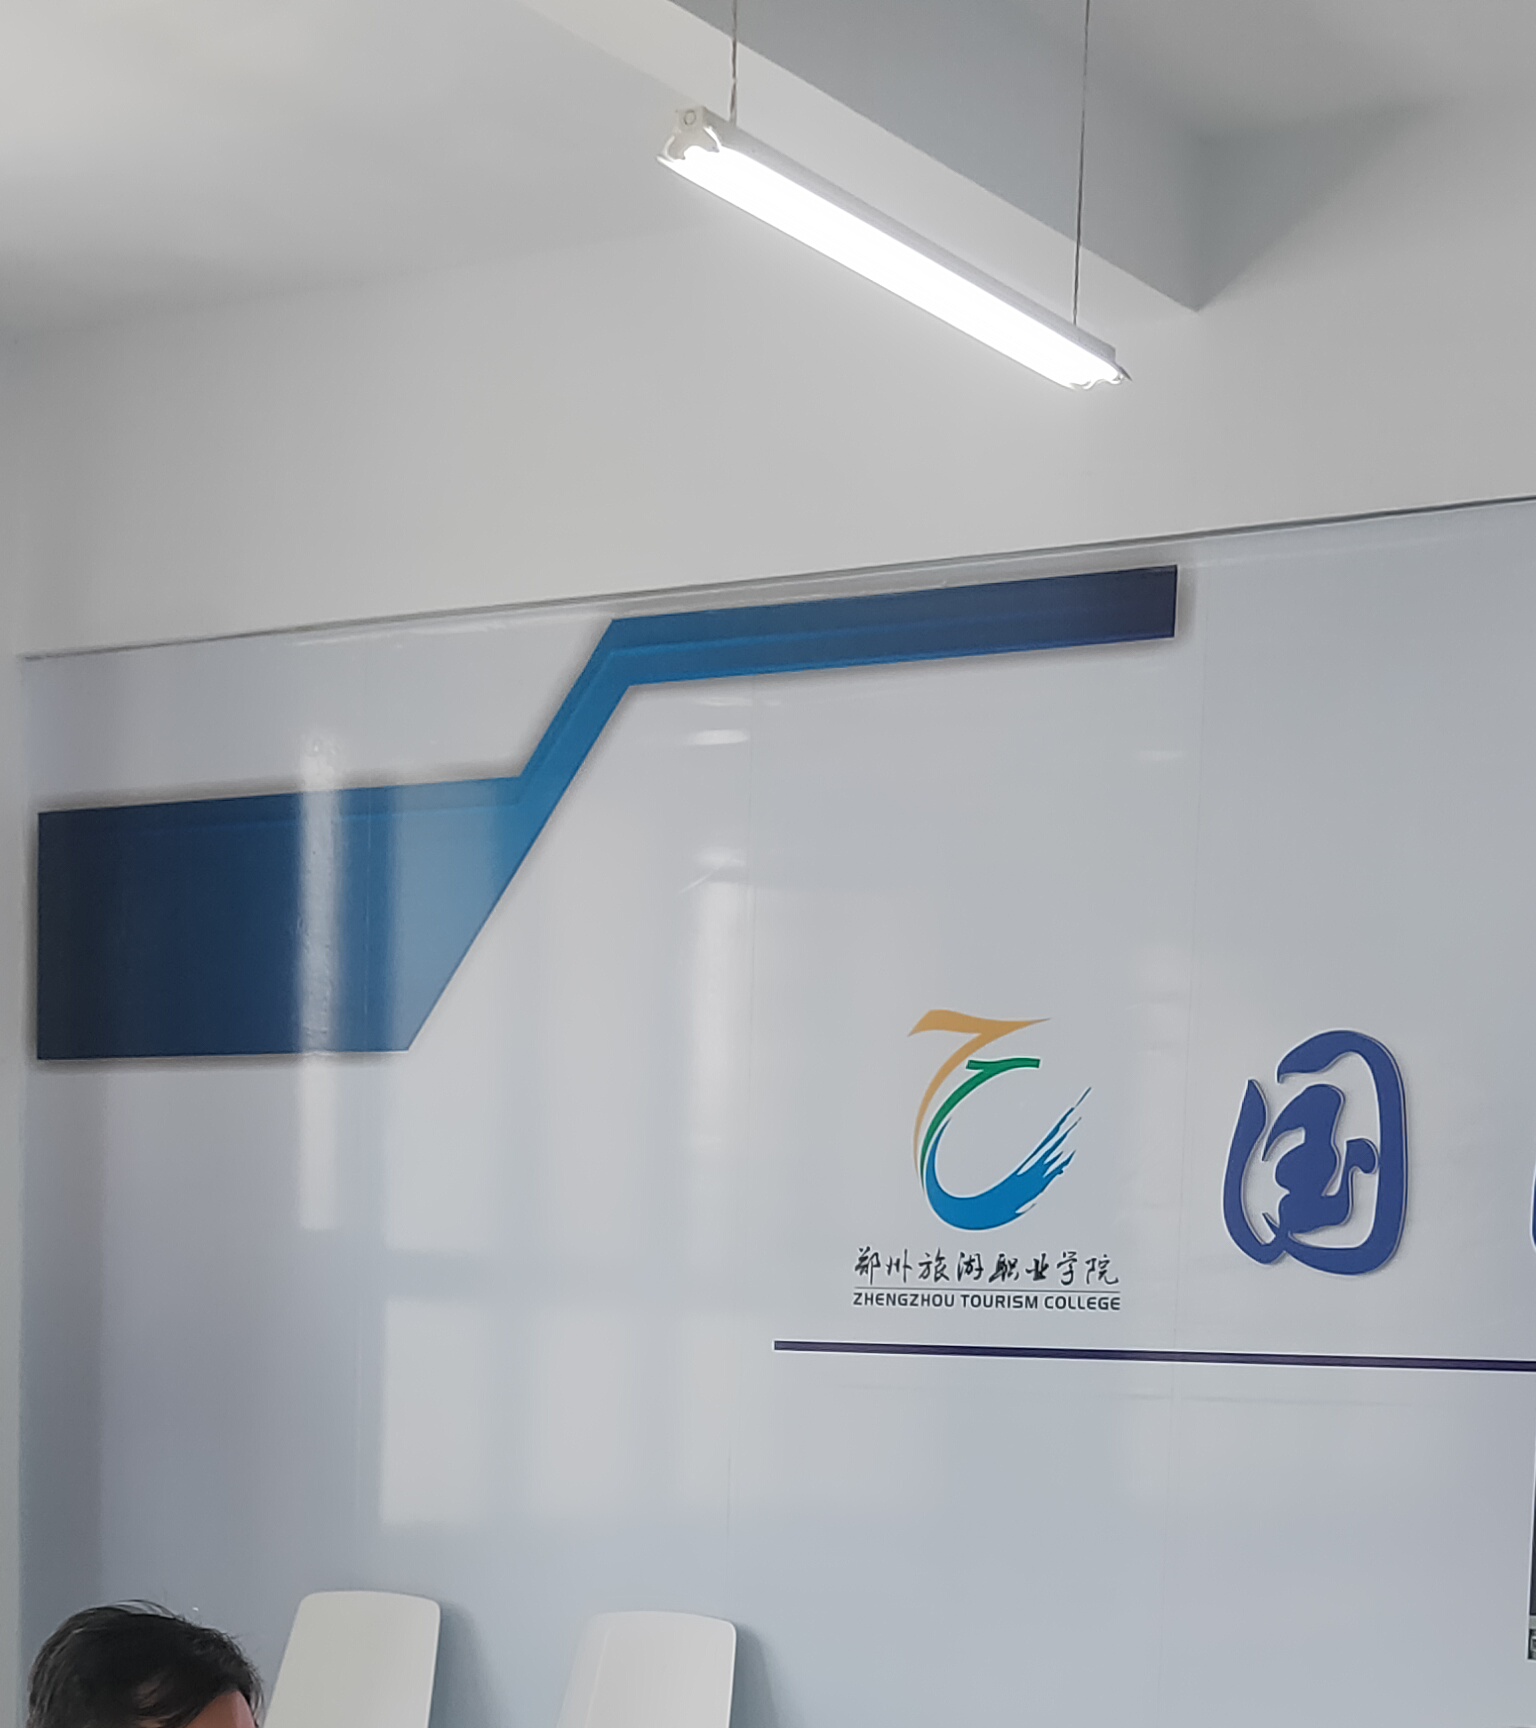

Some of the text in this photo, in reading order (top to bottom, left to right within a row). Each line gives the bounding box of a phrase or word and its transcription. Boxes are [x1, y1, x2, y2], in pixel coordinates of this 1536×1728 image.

[1222, 1029, 1409, 1277] 国
[853, 1246, 1120, 1286] 郑州旅游职业学院
[852, 1292, 1121, 1311] ZHENGZHOU TOURISM COLLEGE
